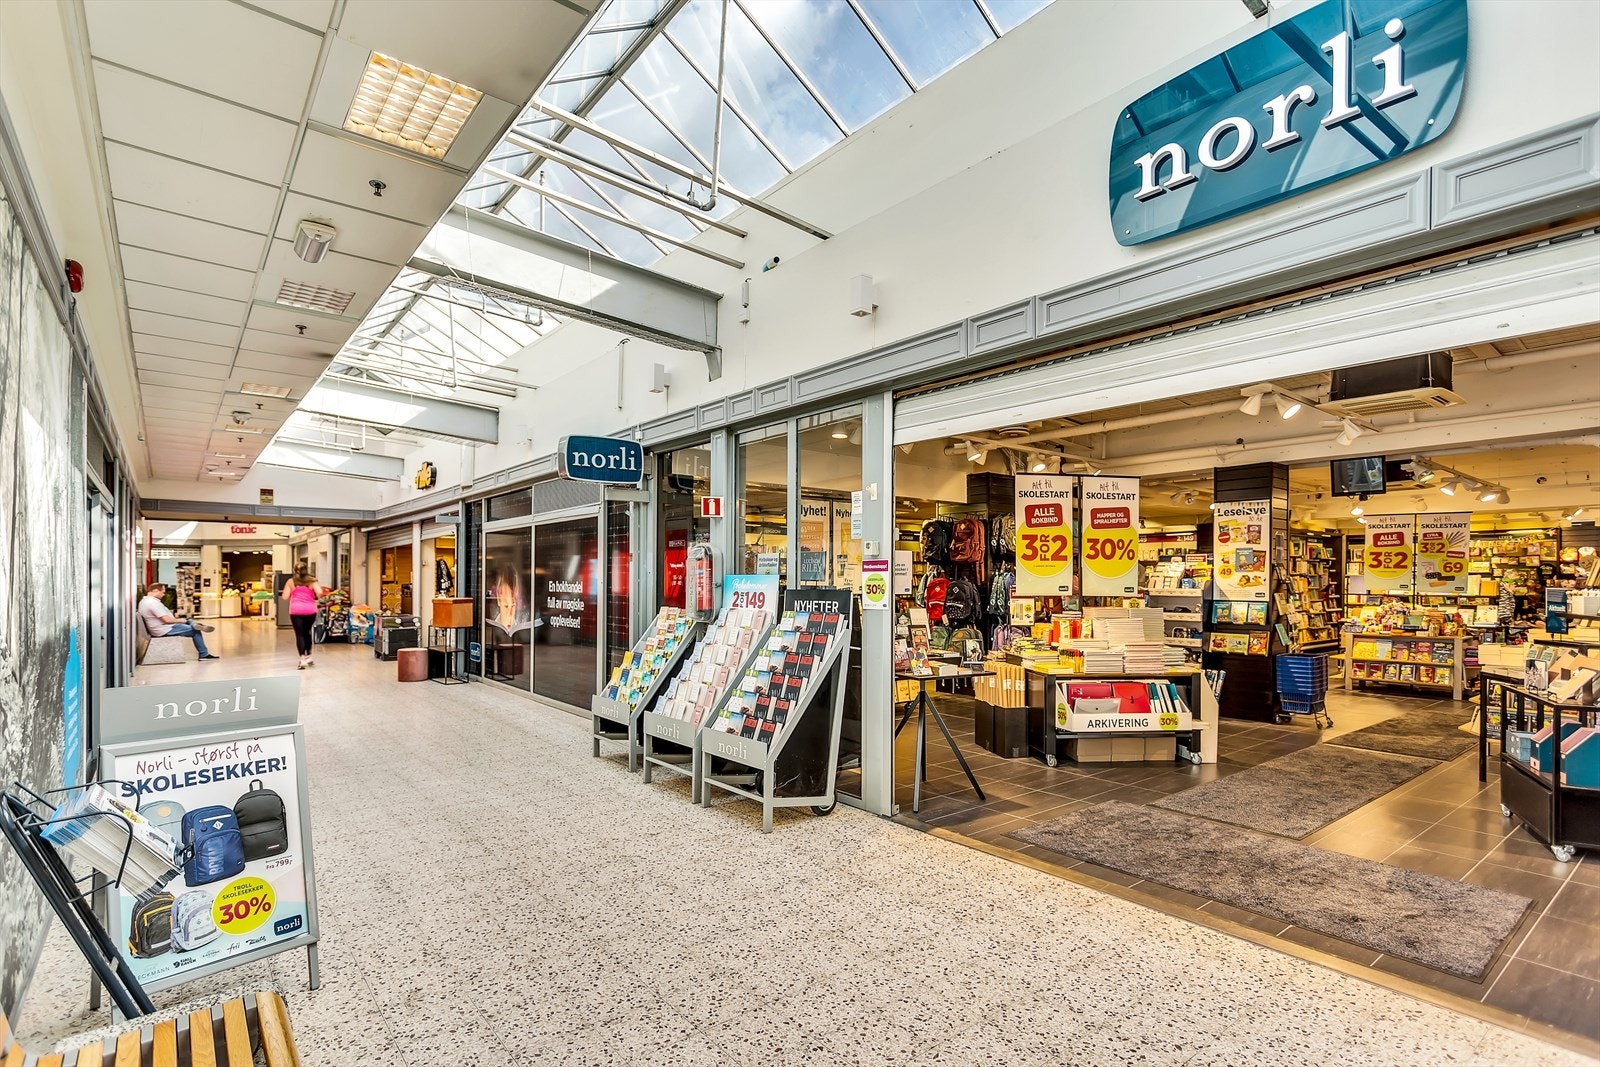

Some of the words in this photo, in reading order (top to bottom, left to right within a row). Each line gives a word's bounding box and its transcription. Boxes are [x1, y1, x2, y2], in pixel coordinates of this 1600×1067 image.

[1133, 18, 1417, 202] norli
[572, 447, 637, 471] norli
[1018, 491, 1069, 499] SKOLESTART
[1086, 492, 1136, 500] SKOLESTART
[836, 508, 852, 518] Nyh
[1034, 508, 1055, 517] ALLE
[1031, 516, 1058, 524] BOKBIND
[231, 525, 257, 534] tonic
[1021, 534, 1038, 561] 3
[1040, 534, 1049, 561] FOR
[1051, 534, 1068, 561] 2
[1086, 538, 1135, 560] 30%
[1420, 543, 1429, 553] 3
[1436, 543, 1445, 553] 2
[1369, 552, 1382, 568] 3
[1384, 552, 1392, 568] FOR
[1393, 552, 1408, 569] 2
[1443, 562, 1463, 573] 69
[548, 581, 556, 592] En
[556, 580, 583, 593] bokhandel
[866, 584, 885, 594] 30%
[547, 596, 556, 608] full
[556, 600, 563, 609] av
[563, 598, 584, 612] magiske
[732, 591, 740, 607] 2
[745, 591, 765, 609] 149
[795, 600, 839, 612] NYHETER
[550, 615, 581, 628] opplevelser!
[154, 686, 258, 720] norli
[601, 704, 619, 718] norli
[1087, 718, 1149, 728] ARKIVERING
[1160, 718, 1178, 726] 30%
[656, 723, 679, 739] norli
[136, 755, 173, 775] Norli
[192, 741, 239, 765] størst
[718, 742, 747, 760] norli
[121, 756, 287, 798] SKOLESEKKER!
[222, 885, 264, 900] SKOLESEKKER
[233, 883, 252, 891] TROLL
[219, 893, 272, 924] 30%
[276, 918, 301, 932] norli
[137, 966, 170, 980] ECKMANN
